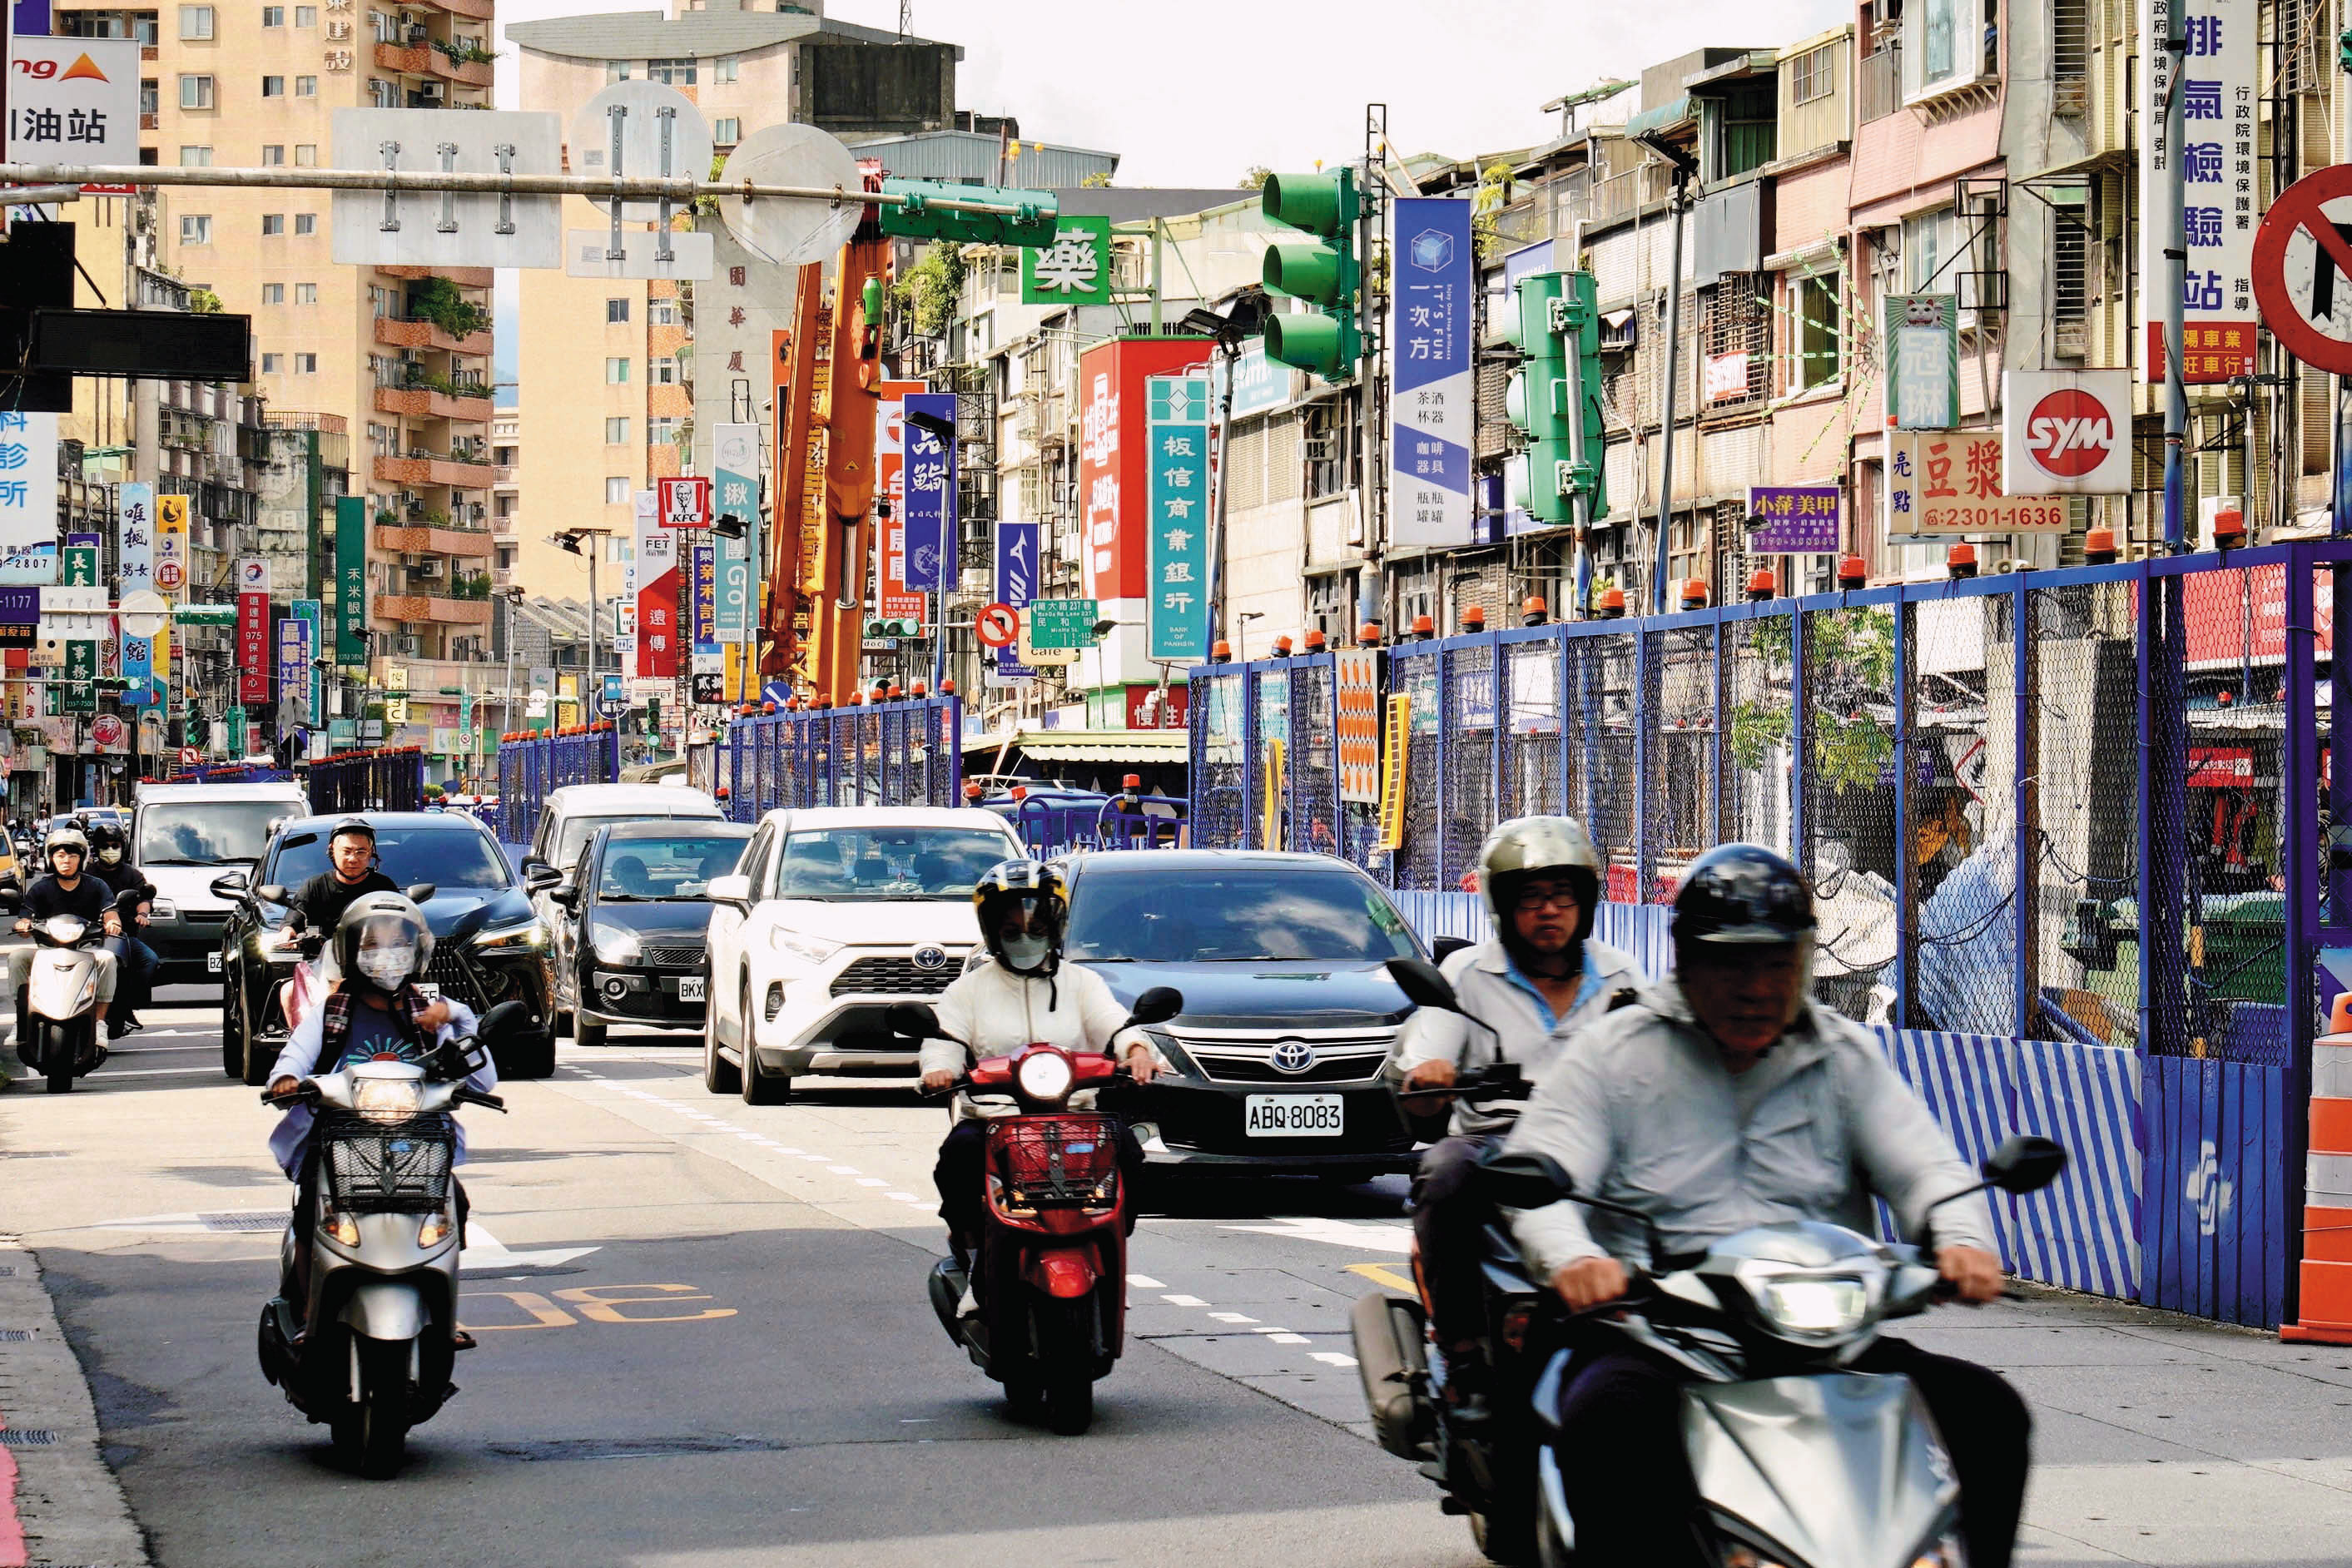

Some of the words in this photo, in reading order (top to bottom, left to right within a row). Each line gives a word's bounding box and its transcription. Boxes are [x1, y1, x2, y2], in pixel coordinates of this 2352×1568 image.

[12, 108, 107, 143] 油站
[2185, 16, 2223, 310] 排氣檢驗站
[2235, 87, 2250, 229] 行政院環境保護署
[1033, 226, 1099, 293] 藥
[2235, 279, 2249, 310] 指導
[1410, 285, 1430, 359] 一次方
[1433, 328, 1444, 360] FUN
[2161, 330, 2241, 348] 陽車業
[2161, 356, 2240, 375] 旺車行
[1417, 441, 1444, 454] 咖啡
[2027, 417, 2112, 459] SYM
[1417, 459, 1444, 474] 器具
[1893, 450, 1912, 514] 亮點
[1923, 439, 2002, 499] 豆漿
[672, 514, 697, 523] KFC
[1753, 494, 1836, 516] 小萍美甲
[1163, 435, 1196, 614] 板信商業銀行
[646, 540, 669, 548] FET
[122, 563, 149, 577] 男女
[347, 568, 361, 633] 禾米眼鏡
[649, 608, 666, 652] 遠傳
[125, 641, 147, 662] 館
[72, 645, 89, 698] 事務所
[697, 717, 726, 727] KFC
